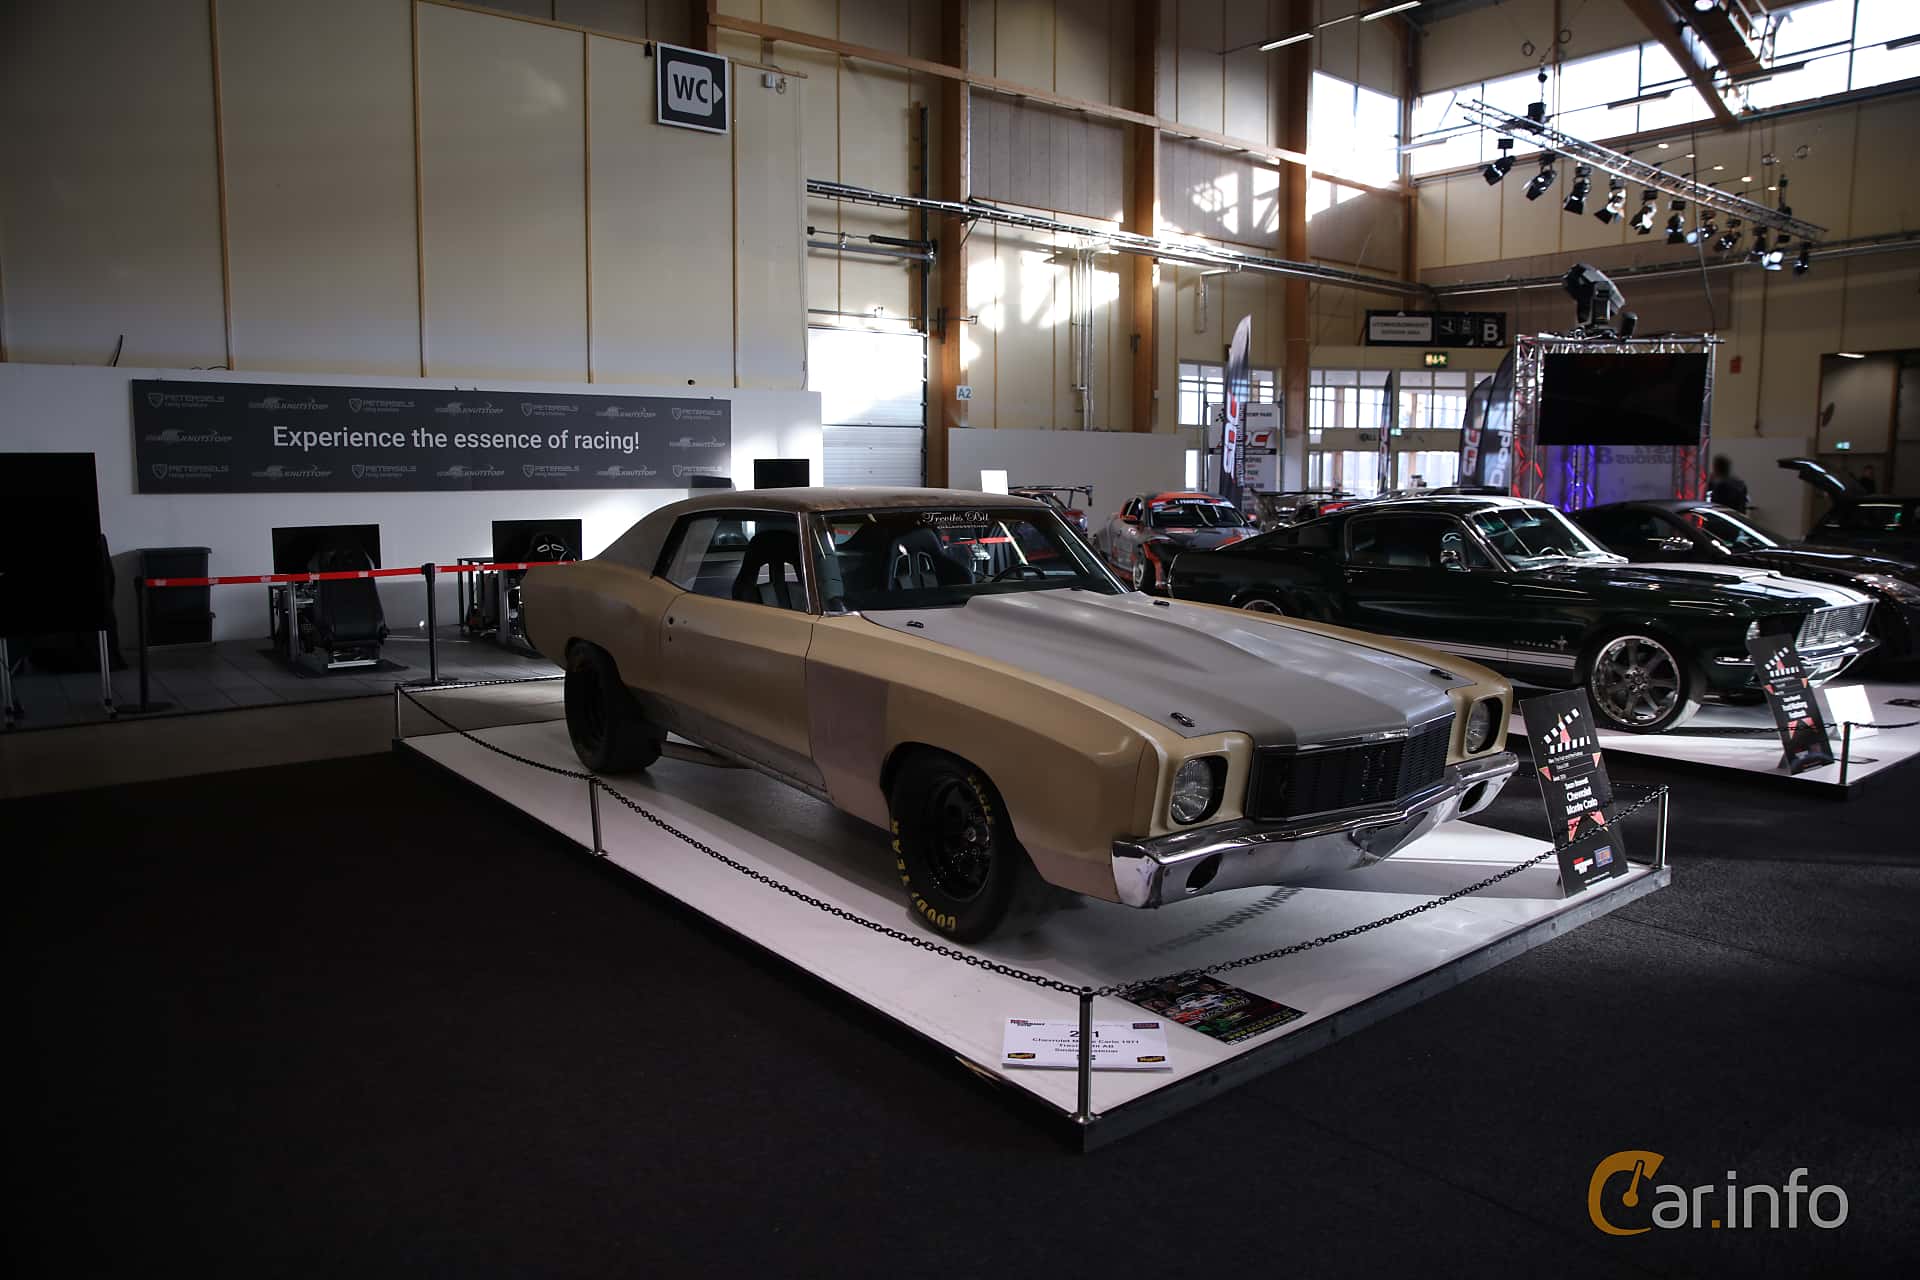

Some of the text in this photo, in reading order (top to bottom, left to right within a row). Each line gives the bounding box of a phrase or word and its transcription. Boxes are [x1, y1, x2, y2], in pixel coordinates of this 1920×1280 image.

[673, 73, 708, 104] WC
[1483, 323, 1499, 341] B
[958, 388, 972, 399] A2
[273, 426, 640, 454] Experience the essence of racing!
